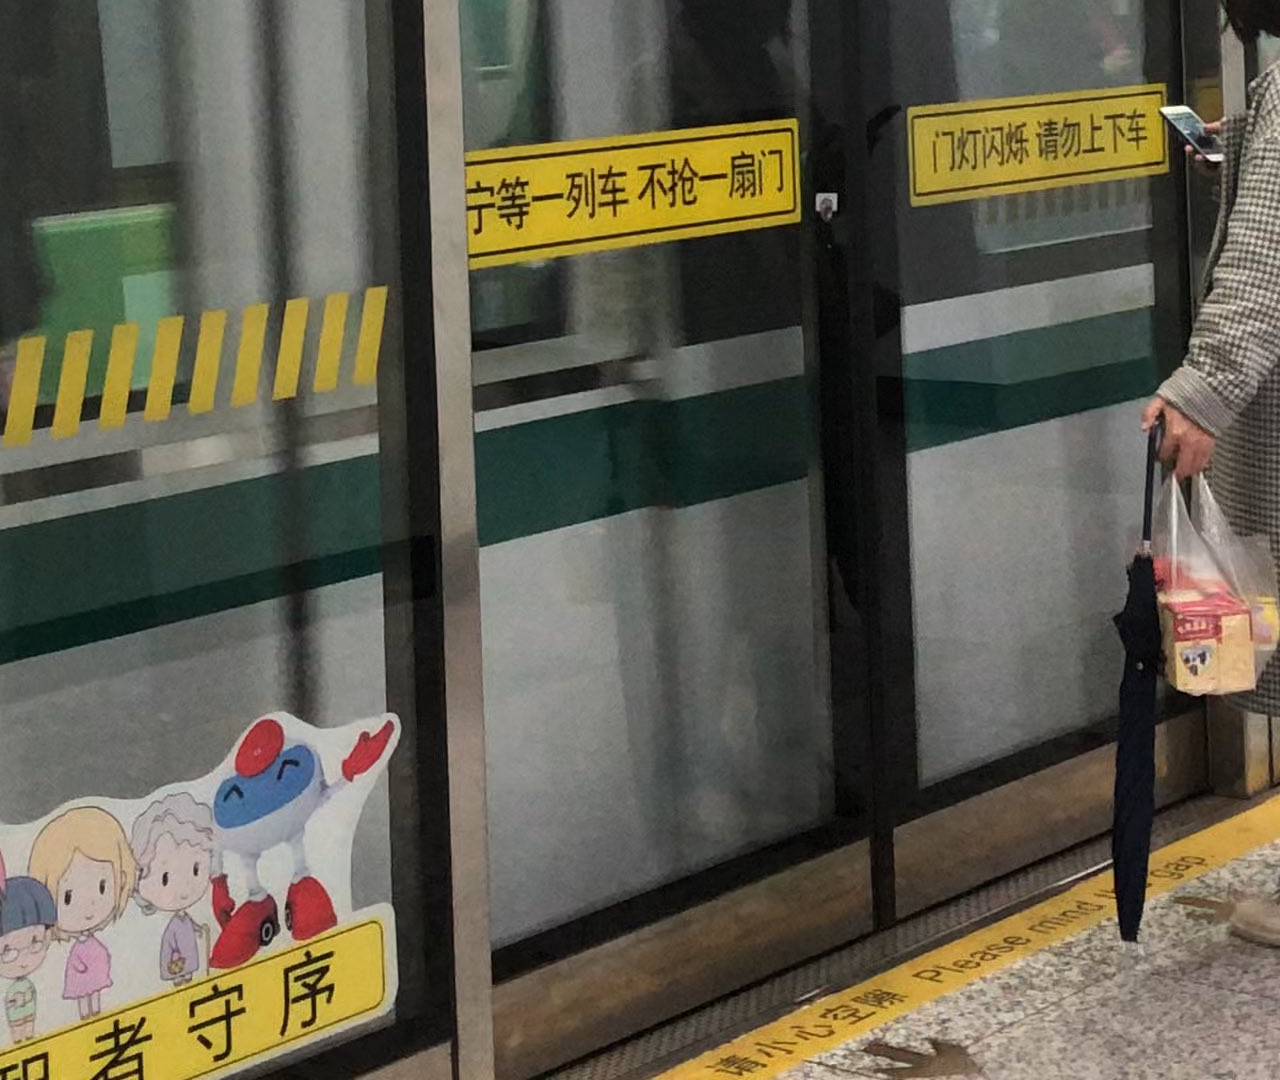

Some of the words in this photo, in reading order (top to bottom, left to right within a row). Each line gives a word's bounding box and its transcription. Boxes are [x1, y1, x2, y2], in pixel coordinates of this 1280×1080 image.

[932, 121, 1029, 174] 门灯闪烁
[1035, 109, 1148, 161] 请勿上下车
[637, 149, 784, 210] 不抢一扇门
[704, 987, 910, 1077] 请小心空隙
[911, 933, 1032, 985] Please
[1028, 899, 1109, 936] mind
